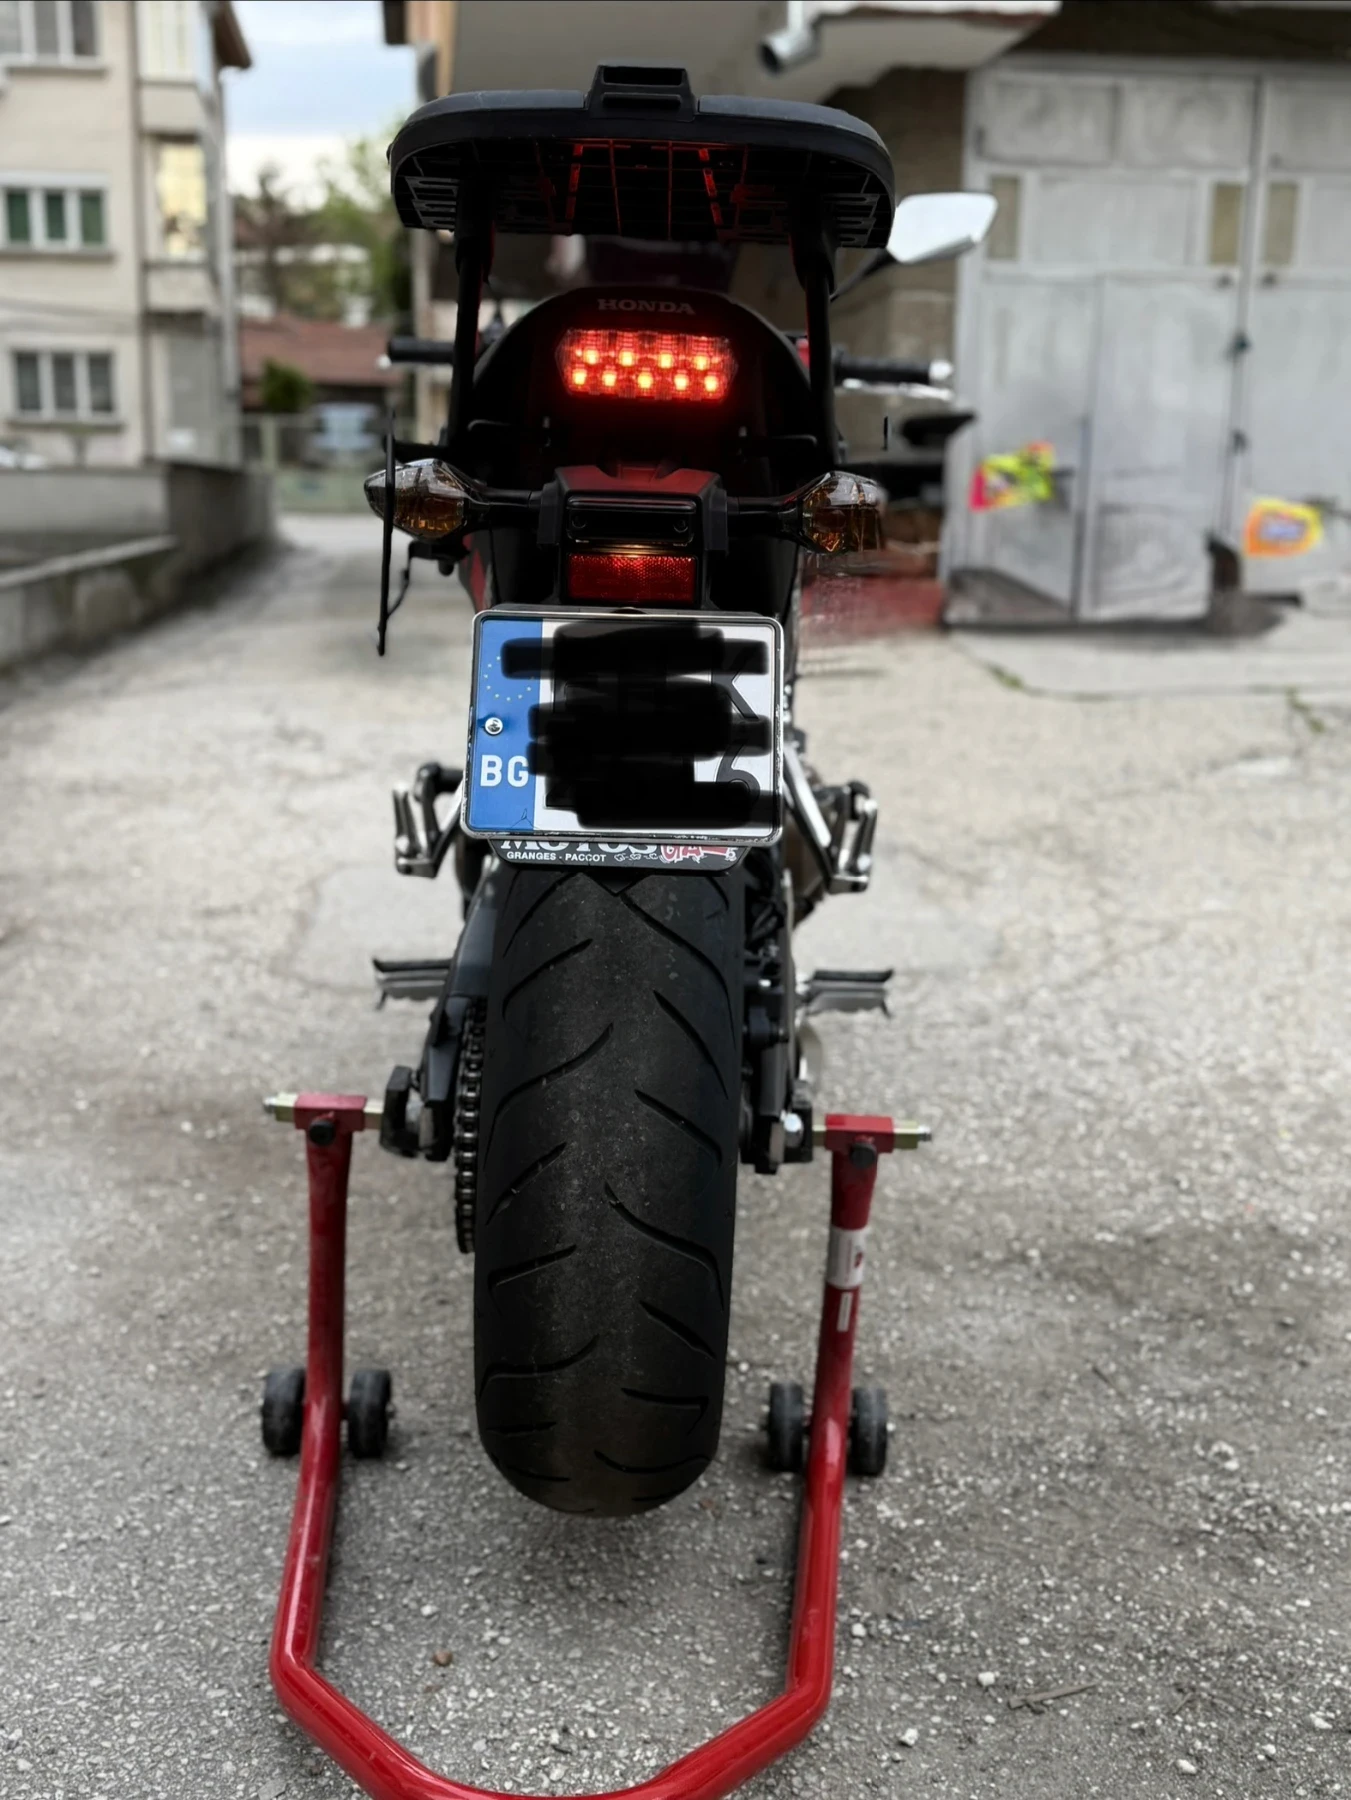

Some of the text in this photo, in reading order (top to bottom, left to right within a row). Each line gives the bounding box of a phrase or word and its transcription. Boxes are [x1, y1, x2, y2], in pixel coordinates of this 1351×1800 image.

[597, 298, 697, 315] HONDA
[480, 754, 529, 788] BG
[506, 851, 557, 860] GRANGES
[565, 853, 607, 862] PACCOT
